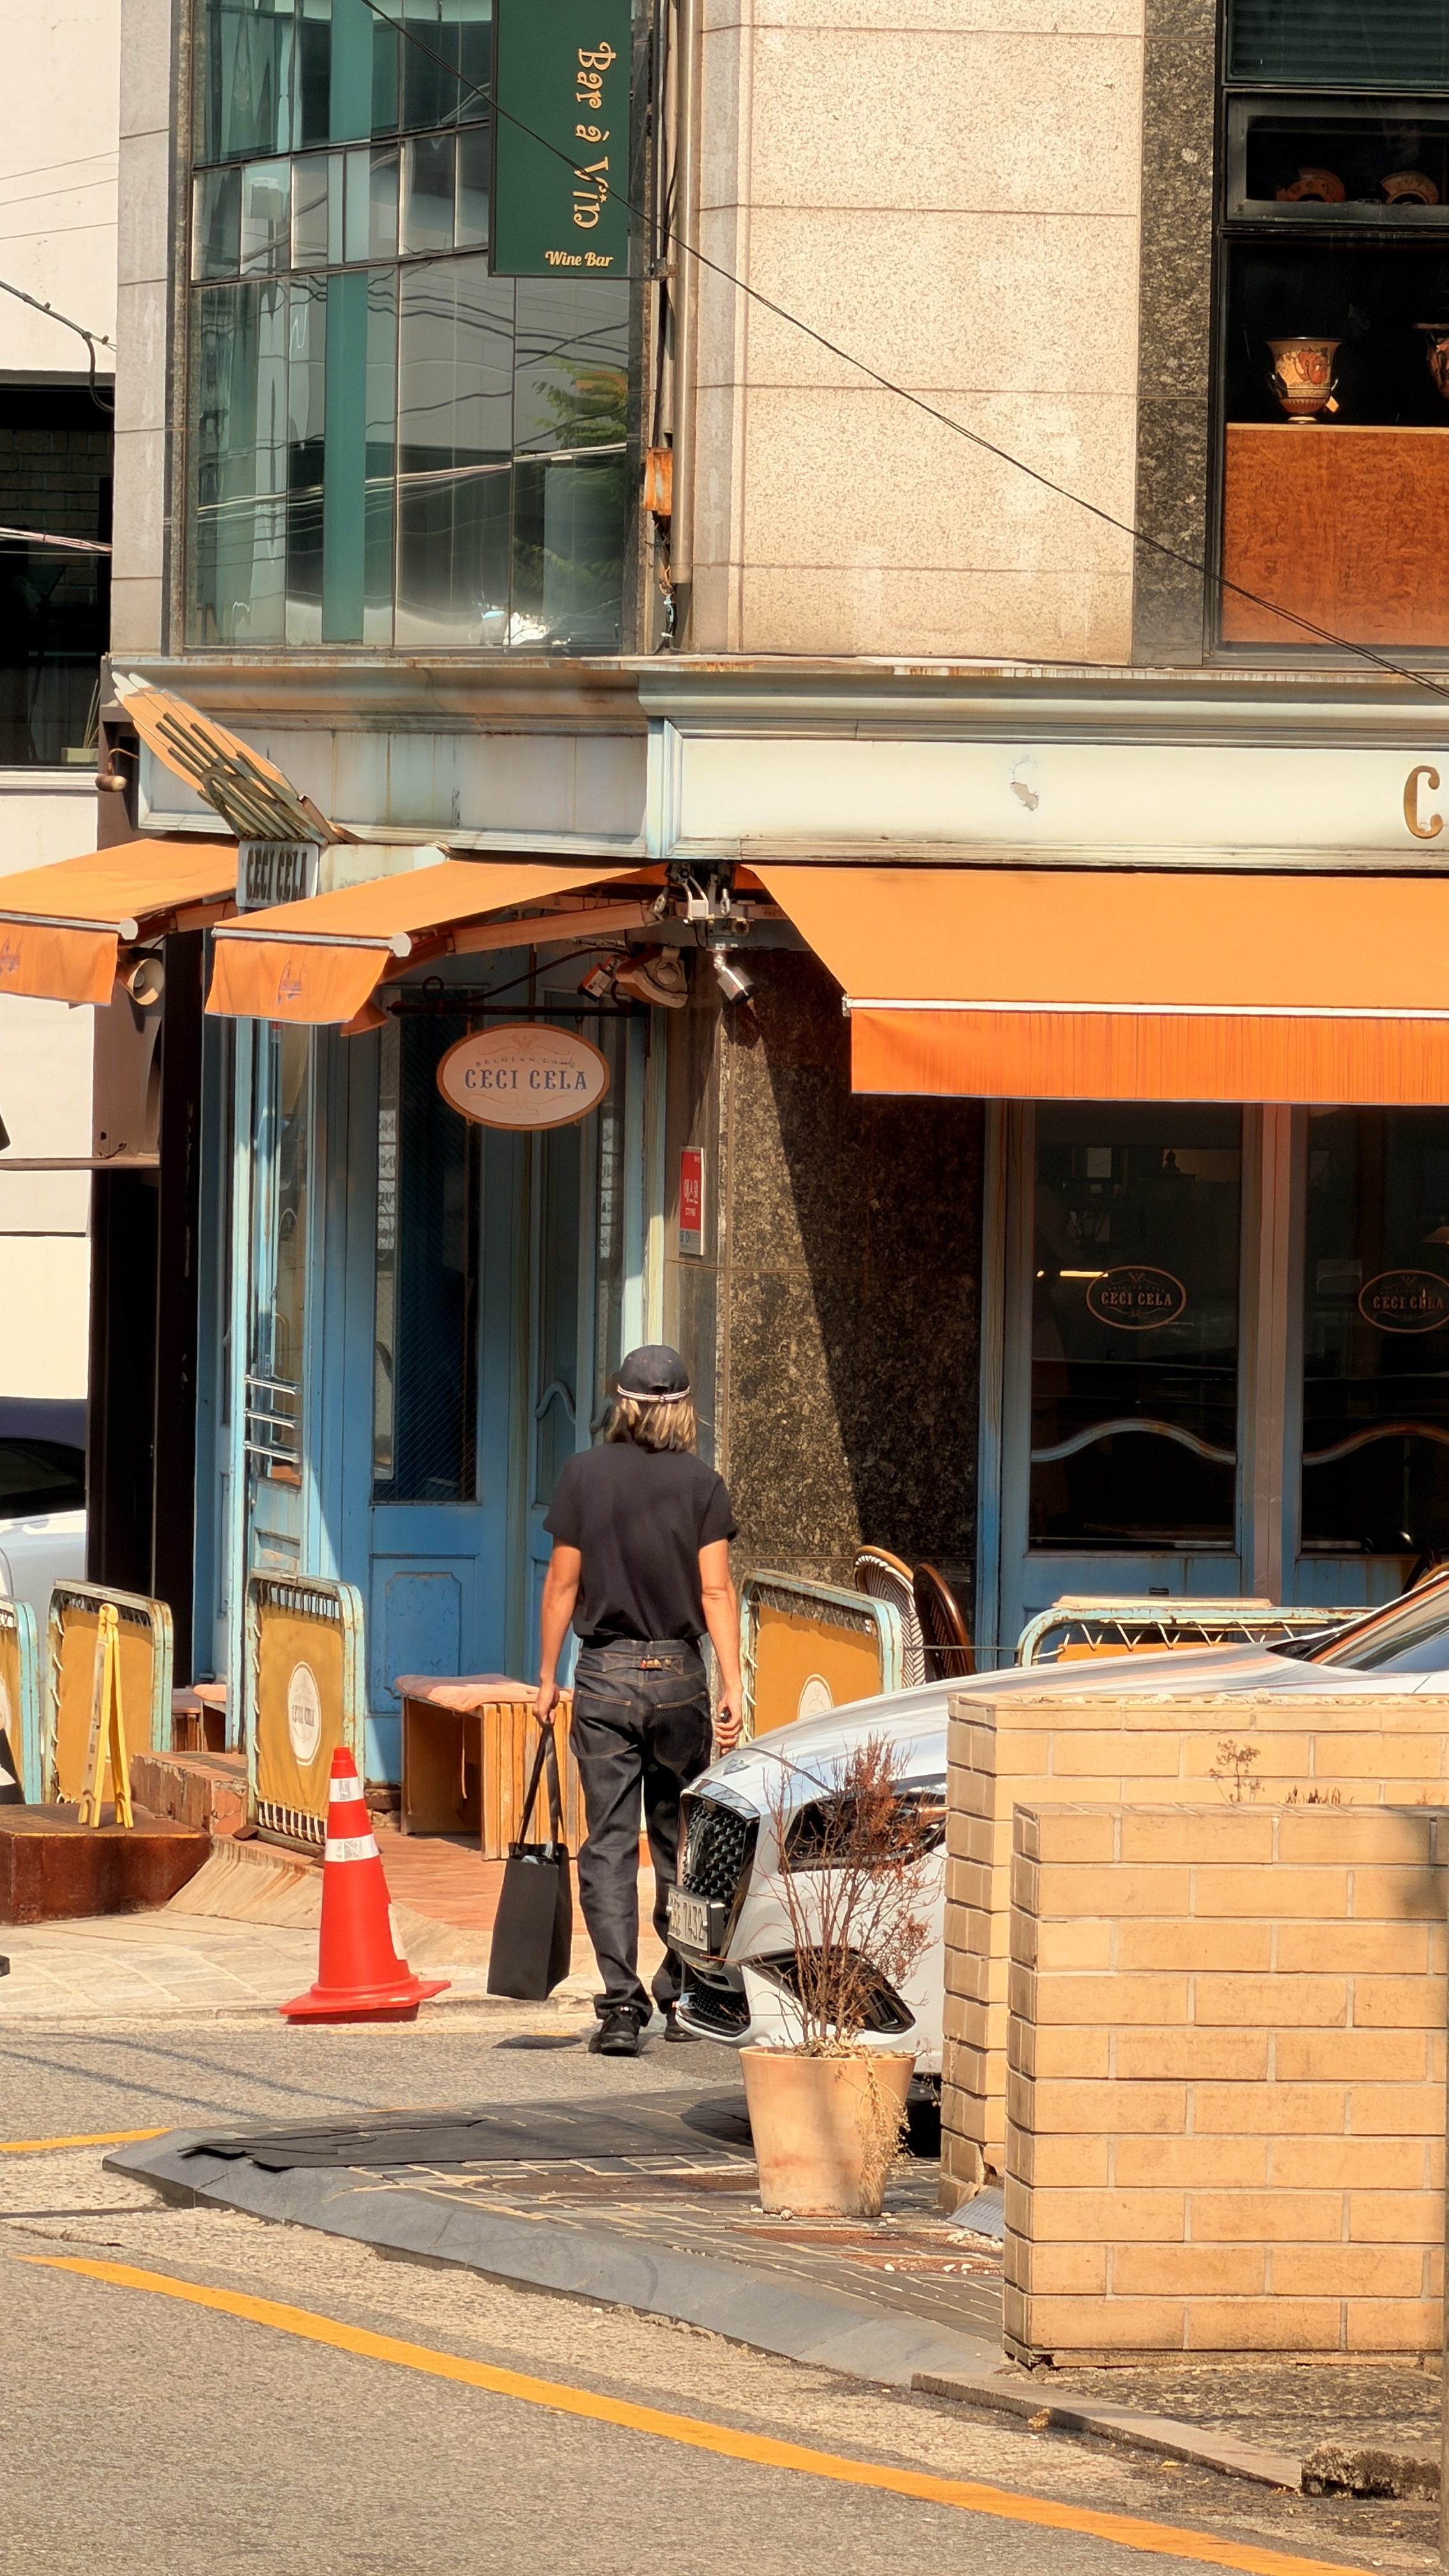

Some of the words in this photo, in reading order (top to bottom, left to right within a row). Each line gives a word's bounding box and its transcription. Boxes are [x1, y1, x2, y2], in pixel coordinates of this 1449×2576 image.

[576, 42, 616, 109] Bar
[572, 156, 610, 229] Vin
[545, 250, 582, 267] Wine
[584, 251, 613, 268] Bar
[246, 847, 275, 900] CECI
[464, 1069, 519, 1089] CECI
[529, 1070, 587, 1090] CELA
[1101, 1291, 1132, 1305] CECI
[1137, 1292, 1172, 1306] CELA
[1373, 1296, 1404, 1309] CECI
